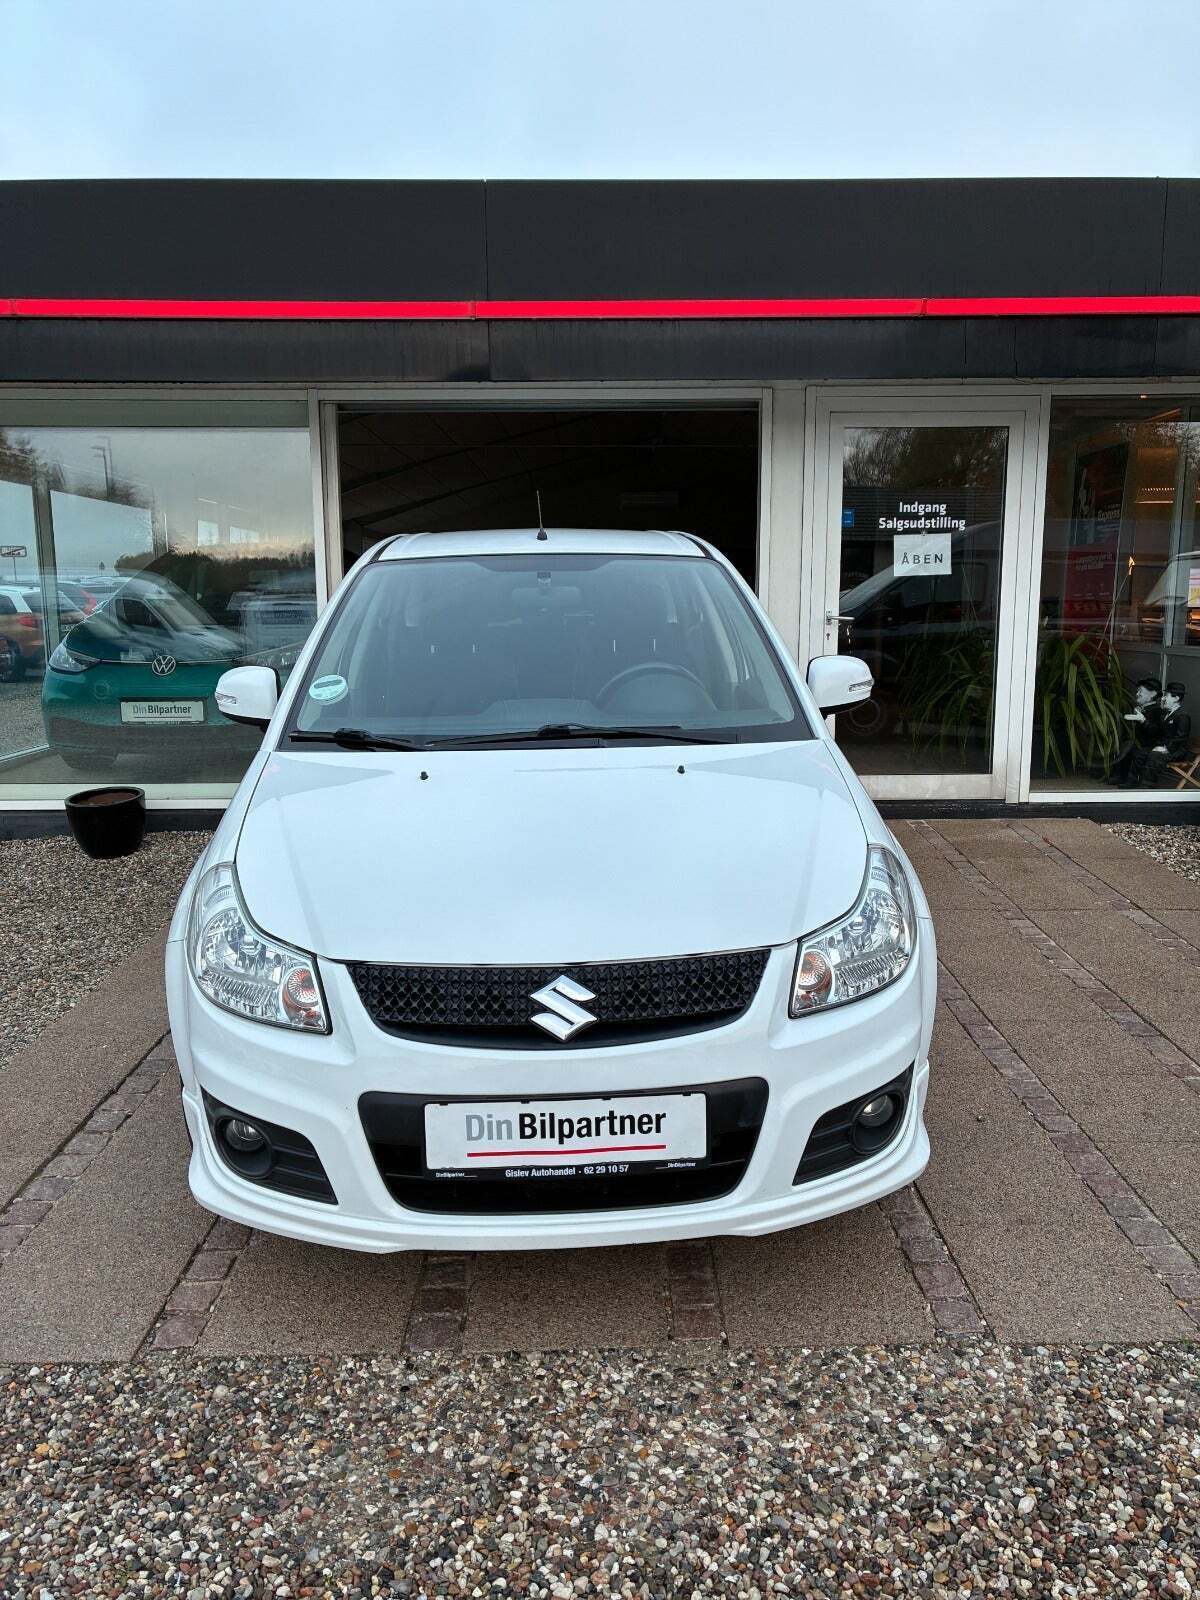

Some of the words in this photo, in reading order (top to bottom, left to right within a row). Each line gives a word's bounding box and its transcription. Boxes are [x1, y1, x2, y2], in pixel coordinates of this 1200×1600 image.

[899, 501, 947, 515] Indgang
[879, 517, 966, 531] Salgsudstilling
[902, 552, 943, 565] ÅBEN
[518, 1110, 667, 1144] Bilpartner
[505, 1169, 529, 1178] Gislev
[531, 1167, 576, 1177] Autohandel
[583, 1166, 594, 1174] 62
[596, 1166, 606, 1174] 29
[608, 1165, 617, 1173] 10
[618, 1164, 630, 1173] 57
